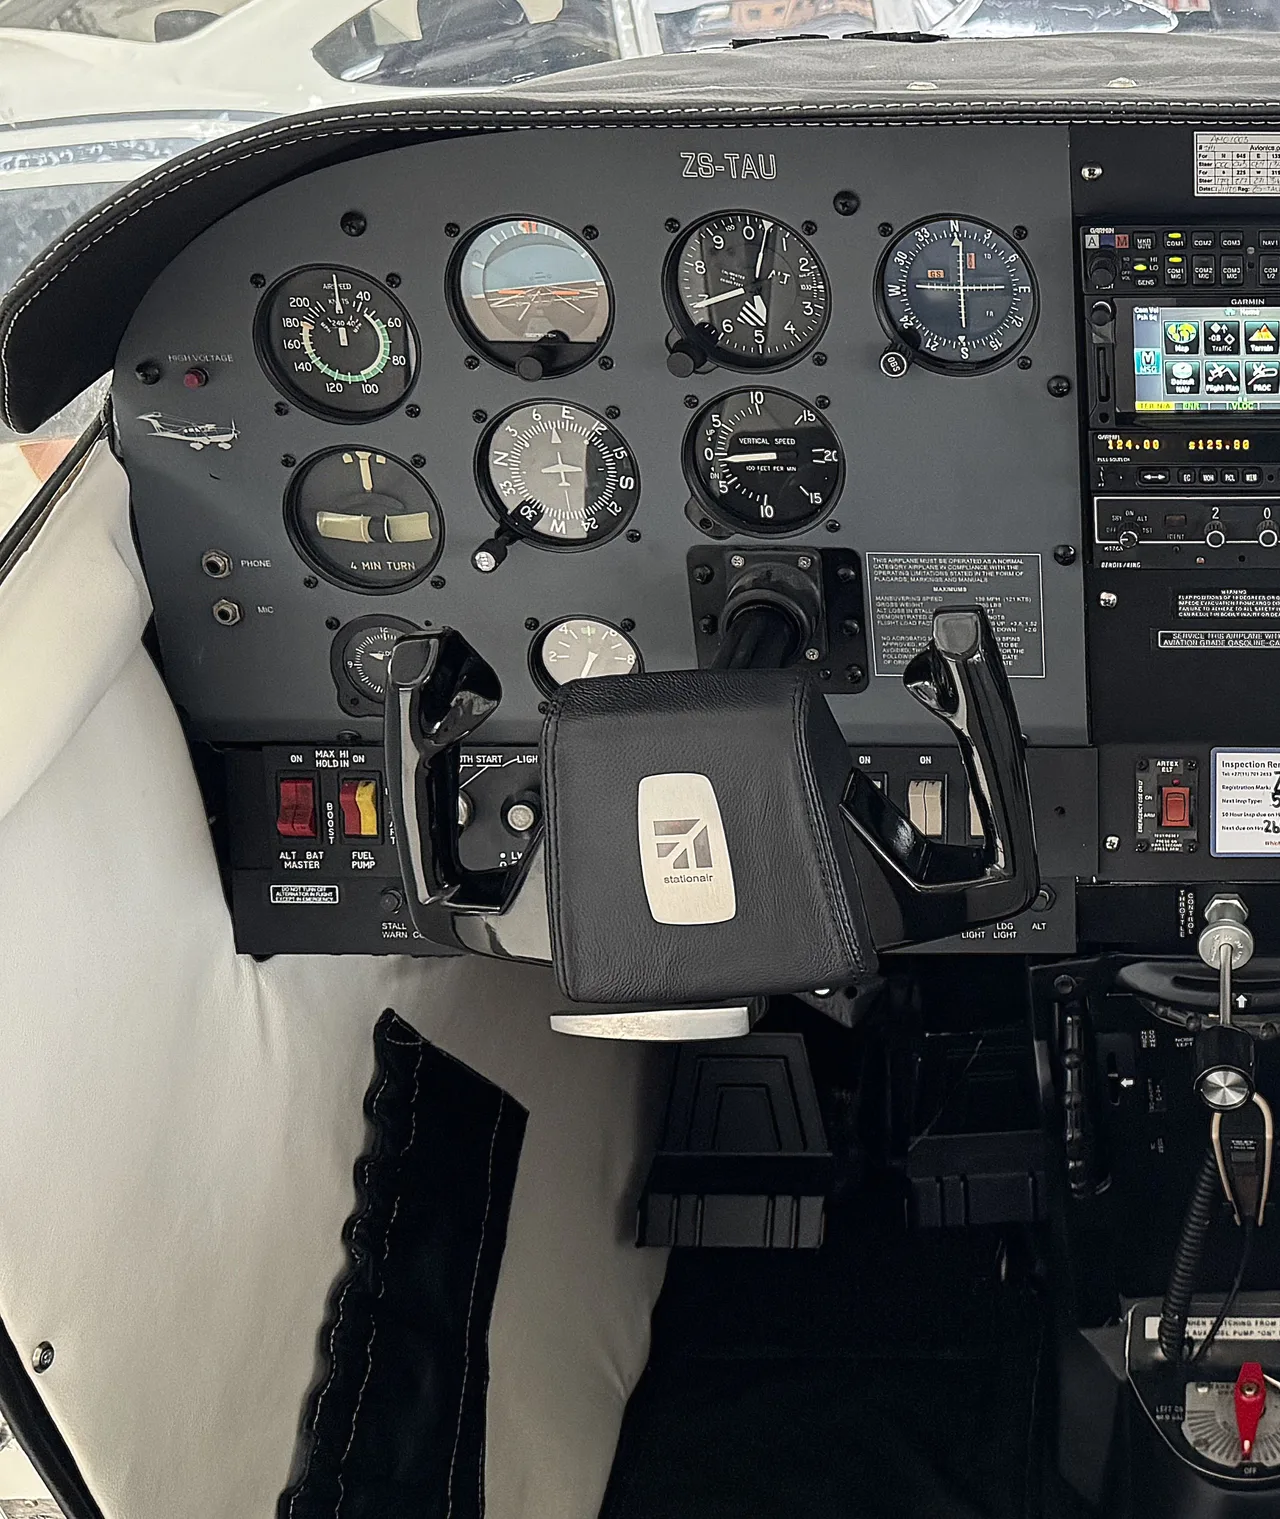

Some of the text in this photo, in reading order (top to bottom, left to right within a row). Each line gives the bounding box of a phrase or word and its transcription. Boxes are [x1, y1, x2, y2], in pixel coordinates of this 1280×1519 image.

[680, 152, 777, 180] ZS-TAU
[950, 220, 959, 232] N
[743, 226, 755, 241] 0
[915, 228, 930, 242] 33
[798, 258, 810, 270] 2
[894, 250, 906, 266] 30
[889, 284, 901, 297] W
[1018, 285, 1031, 294] E
[356, 290, 371, 302] 40
[289, 297, 309, 308] 200
[803, 302, 814, 315] 3
[282, 317, 299, 328] 180
[387, 317, 401, 328] 60
[721, 319, 734, 333] 6
[784, 321, 796, 334] 4
[754, 330, 765, 344] 5
[282, 338, 301, 350] 160
[1212, 344, 1232, 352] Traffic
[168, 354, 233, 362] HIGH VOLTAGE
[392, 354, 406, 366] 80
[887, 355, 902, 372] OBS
[294, 361, 312, 373] 140
[325, 382, 343, 393] 120
[361, 382, 379, 394] 100
[750, 391, 763, 405] 10
[532, 409, 542, 421] 6
[561, 406, 575, 420] E
[802, 410, 816, 422] 15
[711, 414, 721, 428] 5
[591, 421, 607, 436] 12
[738, 437, 796, 445] VERTICAL SPEED
[1107, 439, 1160, 451] 124.00
[493, 451, 509, 466] N
[612, 446, 627, 461] 15
[704, 447, 714, 460] 0
[619, 475, 634, 490] S
[719, 480, 729, 493] 5
[809, 492, 822, 505] 15
[519, 505, 538, 520] 30
[761, 505, 774, 518] 10
[1212, 507, 1219, 519] 2
[550, 521, 567, 535] W
[240, 560, 272, 568] PHONE
[350, 561, 416, 571] 4 MIN TURN
[257, 606, 274, 614] MIC
[290, 754, 303, 764] ON
[315, 749, 349, 759] MAX HI
[352, 754, 365, 764] ON
[475, 755, 503, 765] START
[859, 755, 871, 765] ON
[919, 755, 932, 765] ON
[315, 759, 350, 769] HOLD IN
[1221, 761, 1265, 770] Inspection
[326, 802, 334, 845] BOOST
[279, 851, 324, 861] ALT BAT
[352, 851, 374, 861] FUEL
[284, 860, 320, 870] MASTER
[351, 860, 376, 870] PUMP
[663, 873, 713, 884] stationair
[381, 921, 407, 931] STALL
[996, 922, 1014, 930] LDG
[381, 930, 408, 940] WARN
[961, 931, 985, 939] LIGHT
[993, 931, 1017, 939] LIGHT
